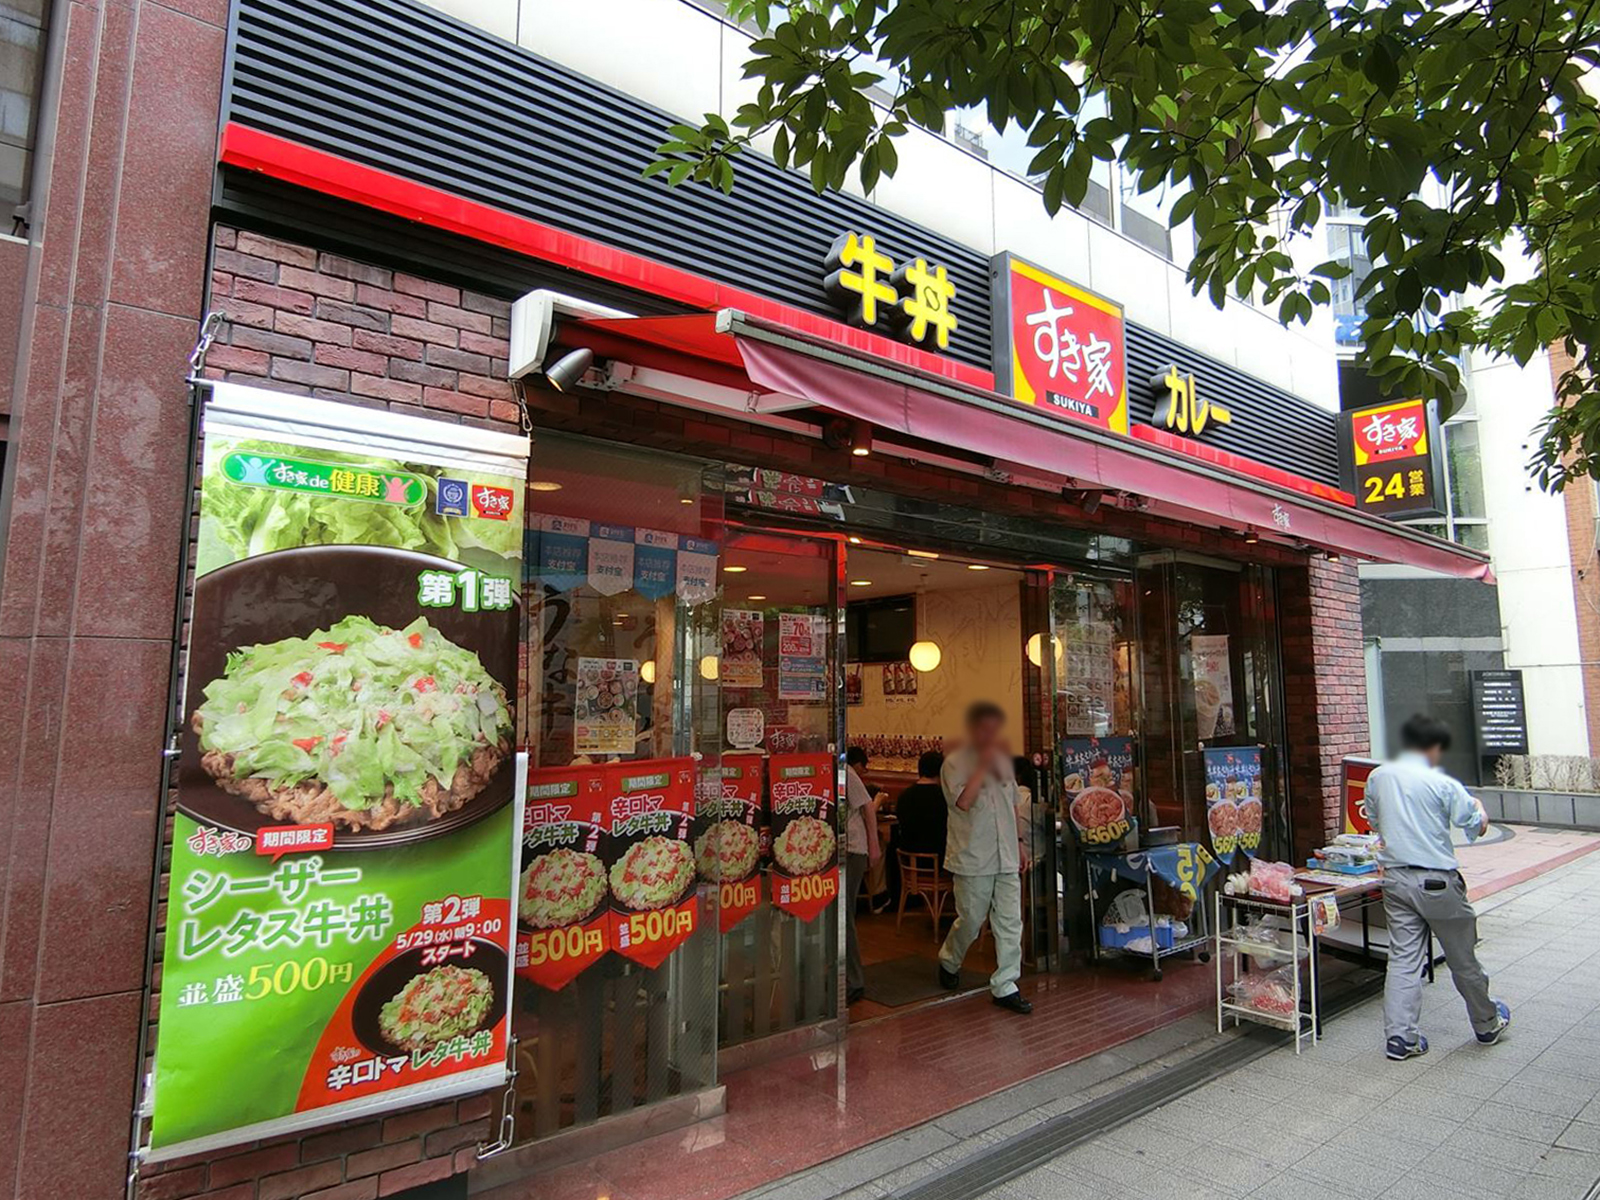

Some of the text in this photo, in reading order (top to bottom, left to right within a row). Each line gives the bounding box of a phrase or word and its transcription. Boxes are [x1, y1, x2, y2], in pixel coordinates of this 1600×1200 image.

[838, 231, 958, 350] 牛丼
[1026, 288, 1116, 400] すき家
[1052, 393, 1094, 418] SUKIYA
[1164, 364, 1232, 436] カレー
[1362, 414, 1419, 446] すき家
[1364, 472, 1406, 504] 24
[1408, 469, 1425, 497] 営業
[476, 487, 512, 512] すき家
[596, 565, 624, 577] 支付宝
[640, 570, 667, 582] 支付宝
[420, 569, 512, 610] 第1弾
[773, 781, 813, 799] 辛口トマ
[611, 794, 664, 818] 辛口トマ
[775, 796, 816, 815] レタ牛丼
[262, 828, 328, 848] 期間限定
[612, 812, 672, 837] レタ牛丼
[187, 826, 252, 857] すき家の
[185, 858, 359, 911] シーザー
[791, 875, 835, 903] 500円
[423, 896, 481, 925] 第2弾
[183, 896, 391, 957] レタス牛丼
[630, 908, 693, 945] 500円
[421, 941, 477, 965] スタート
[530, 926, 603, 965] 500円
